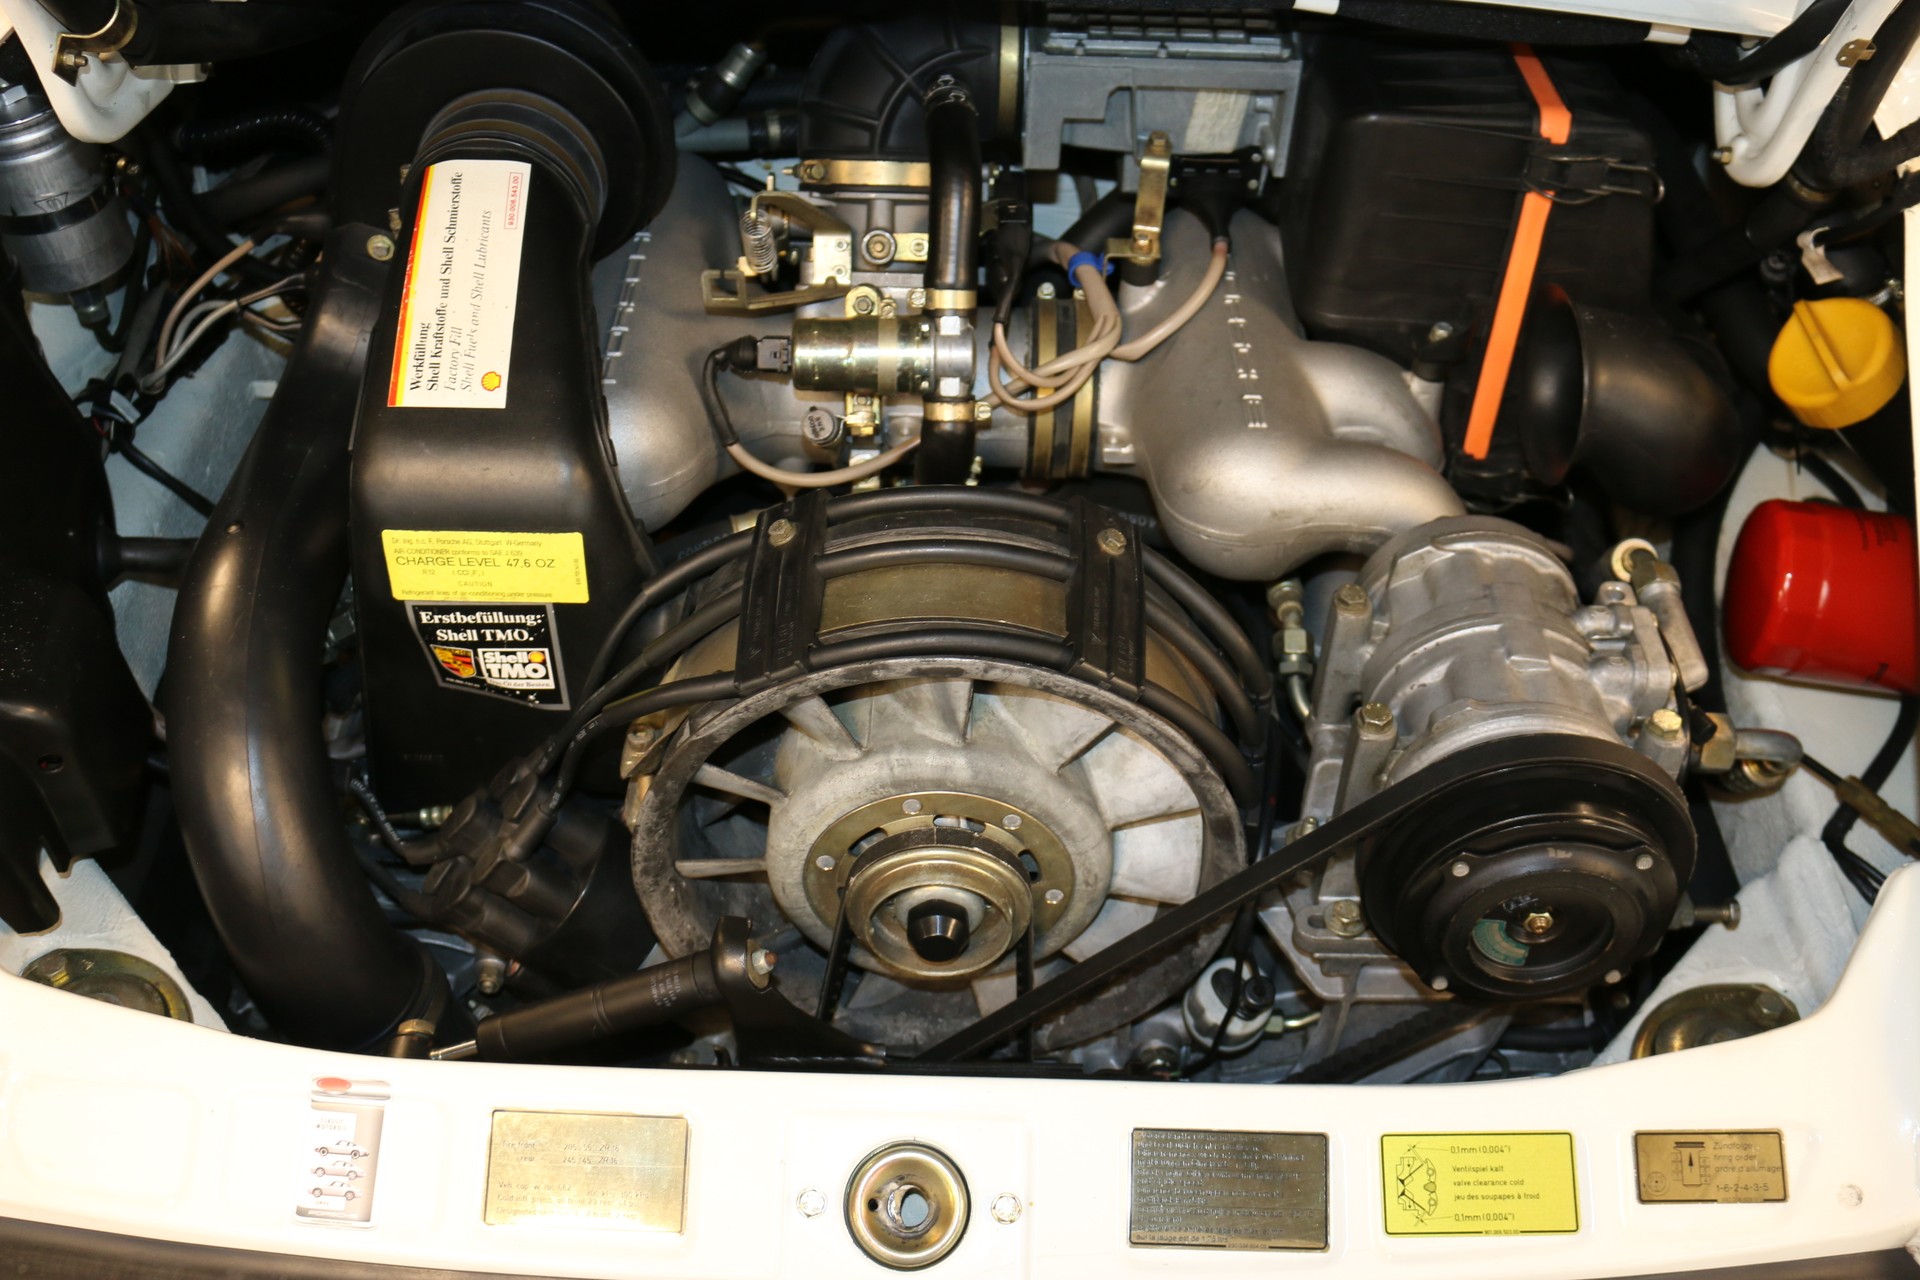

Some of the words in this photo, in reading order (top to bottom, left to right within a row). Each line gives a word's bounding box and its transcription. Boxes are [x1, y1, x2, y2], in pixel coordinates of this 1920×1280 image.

[444, 172, 463, 243] Schmierstoffe
[473, 210, 492, 268] Lubricants
[441, 247, 454, 274] Shell
[439, 278, 451, 299] und
[470, 272, 485, 300] Shell
[469, 303, 481, 326] and
[431, 302, 447, 358] Kraftstoffe
[449, 326, 462, 346] Fill
[464, 329, 477, 358] Fuels
[410, 322, 431, 391] Werkfüllung
[427, 362, 441, 391] Shell
[444, 348, 461, 391] Factory
[461, 362, 475, 392] Shell
[436, 538, 461, 546] Porsche
[396, 556, 455, 567] CHARGE
[459, 557, 501, 568] LEVEL
[535, 559, 556, 569] OZ
[402, 589, 434, 597] Refrigerant
[420, 611, 542, 626] Erstbefüllung:
[436, 629, 478, 642] Shell
[480, 630, 535, 642] TMO.
[484, 651, 529, 664] Shell
[485, 663, 547, 680] TMO
[517, 1141, 535, 1149] front
[1713, 1154, 1734, 1162] firing
[1452, 1165, 1488, 1173] Ventilspiel
[1490, 1165, 1504, 1173] kalt
[1453, 1193, 1465, 1202] jeu
[1481, 1193, 1515, 1202] soupapes
[1523, 1192, 1540, 1200] froid
[1716, 1182, 1769, 1192] 1-6-2-4-3-5
